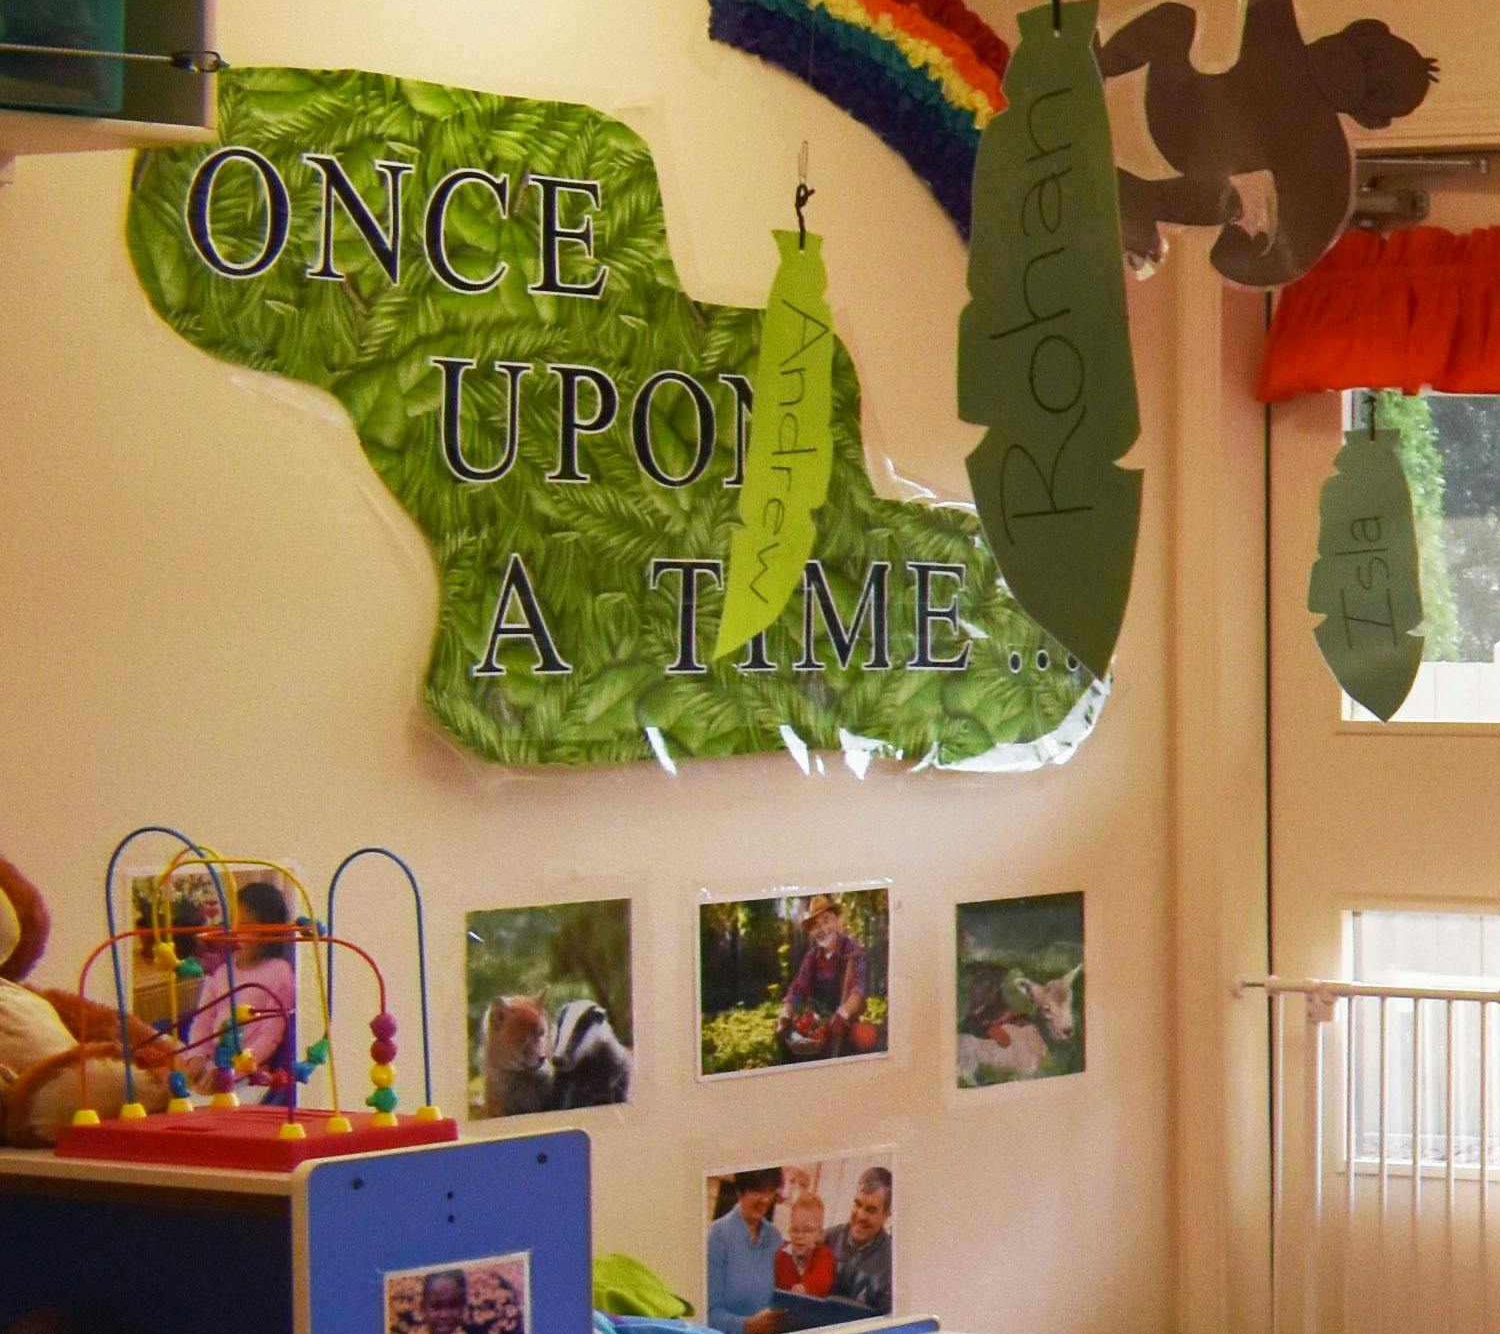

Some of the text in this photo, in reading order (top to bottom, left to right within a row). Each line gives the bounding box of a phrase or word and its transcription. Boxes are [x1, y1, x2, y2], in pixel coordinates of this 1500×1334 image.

[185, 144, 609, 299] ONCE
[989, 86, 1094, 545] Rohan
[749, 298, 831, 604] Andrew
[472, 552, 573, 677] A
[1334, 515, 1399, 650] Isla
